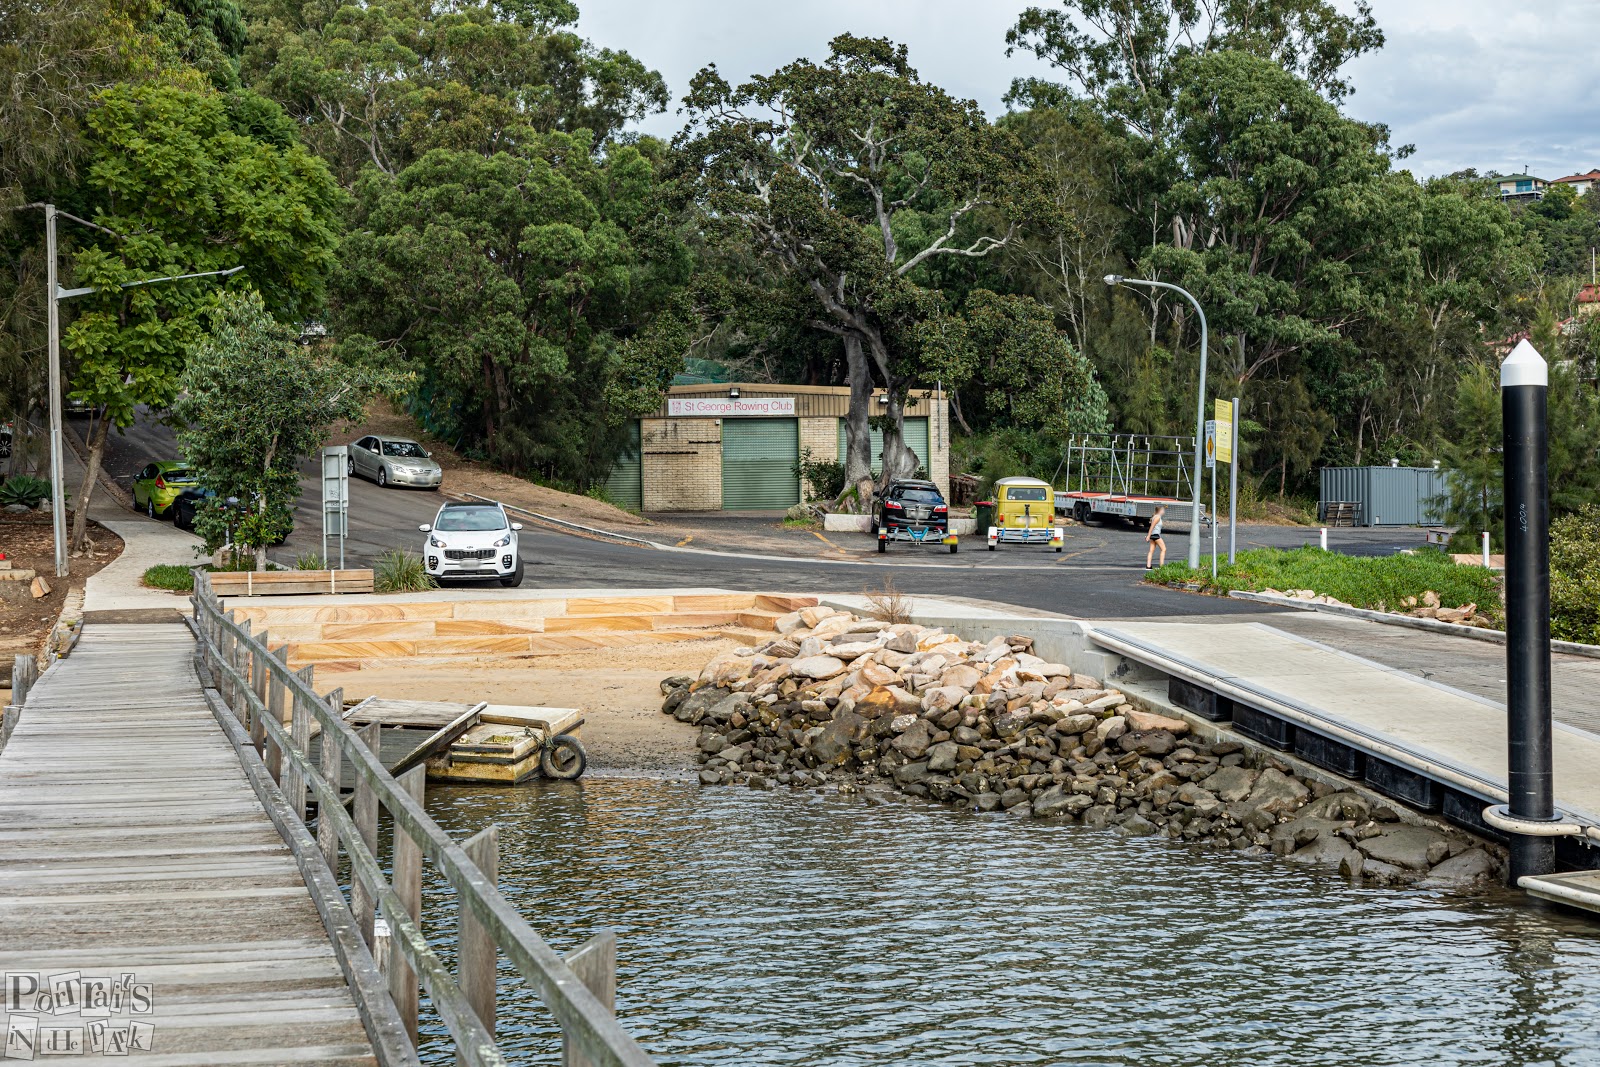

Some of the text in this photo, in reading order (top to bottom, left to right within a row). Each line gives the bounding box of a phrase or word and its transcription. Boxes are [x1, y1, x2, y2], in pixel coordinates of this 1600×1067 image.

[685, 401, 792, 413] St George Rowing Club
